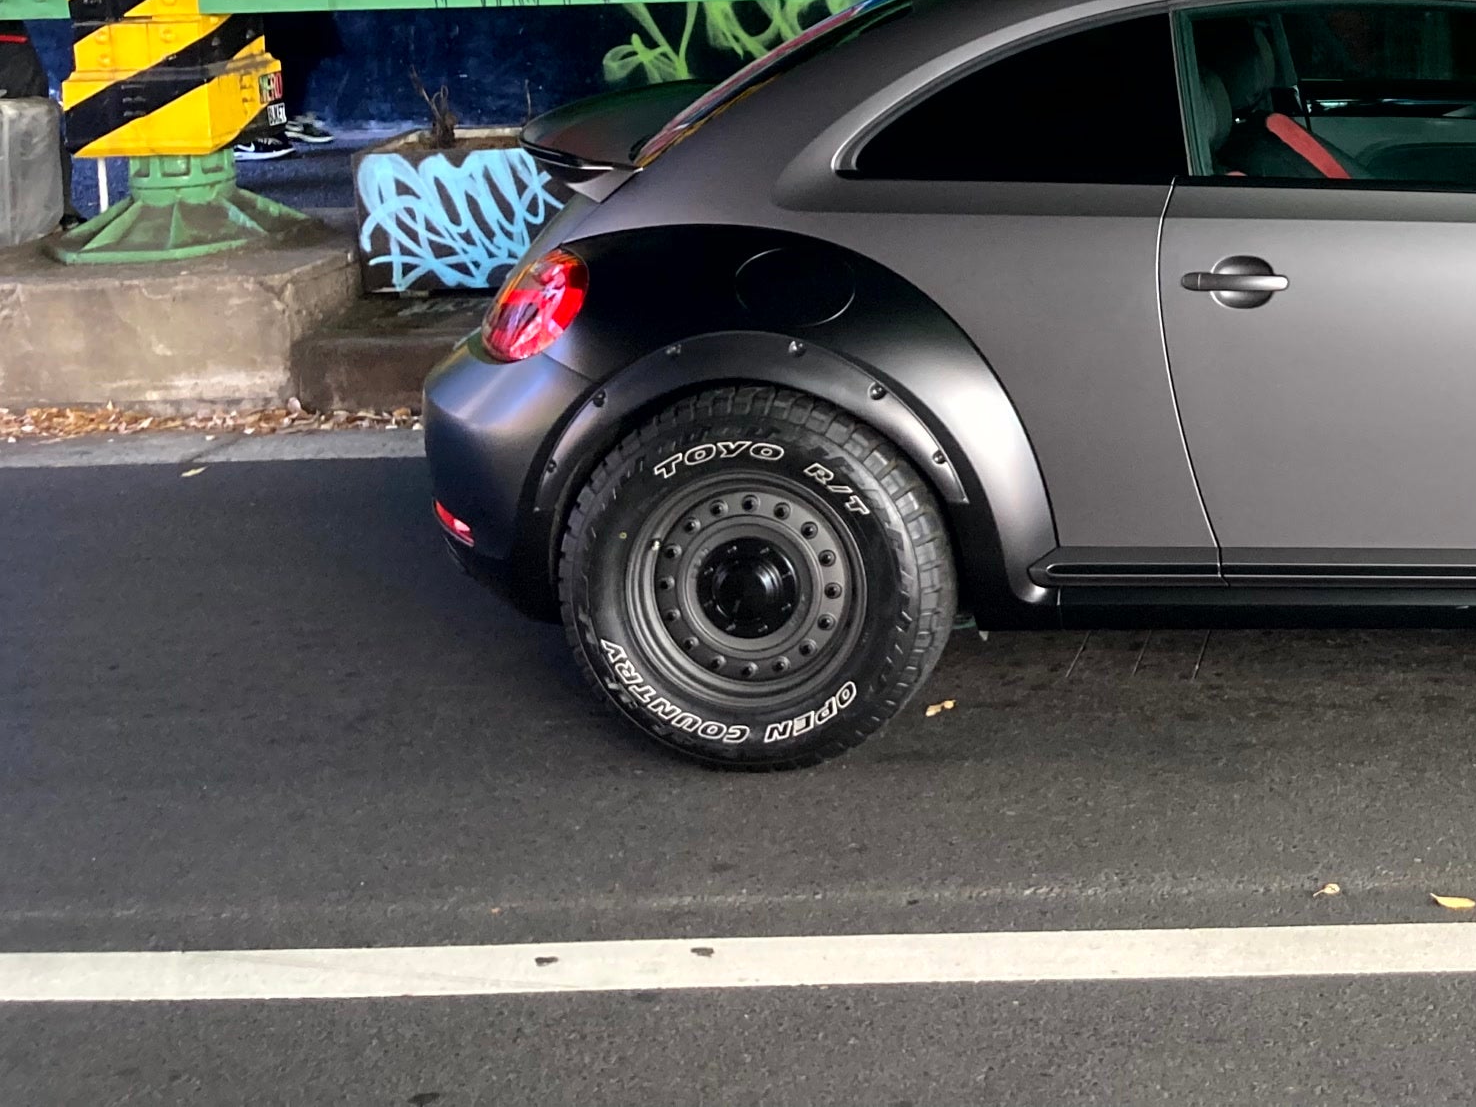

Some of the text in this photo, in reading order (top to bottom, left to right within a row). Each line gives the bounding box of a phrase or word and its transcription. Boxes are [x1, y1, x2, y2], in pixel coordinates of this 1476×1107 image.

[653, 440, 871, 517] TOYO R/T
[600, 638, 858, 745] OPEN COUNTRY
